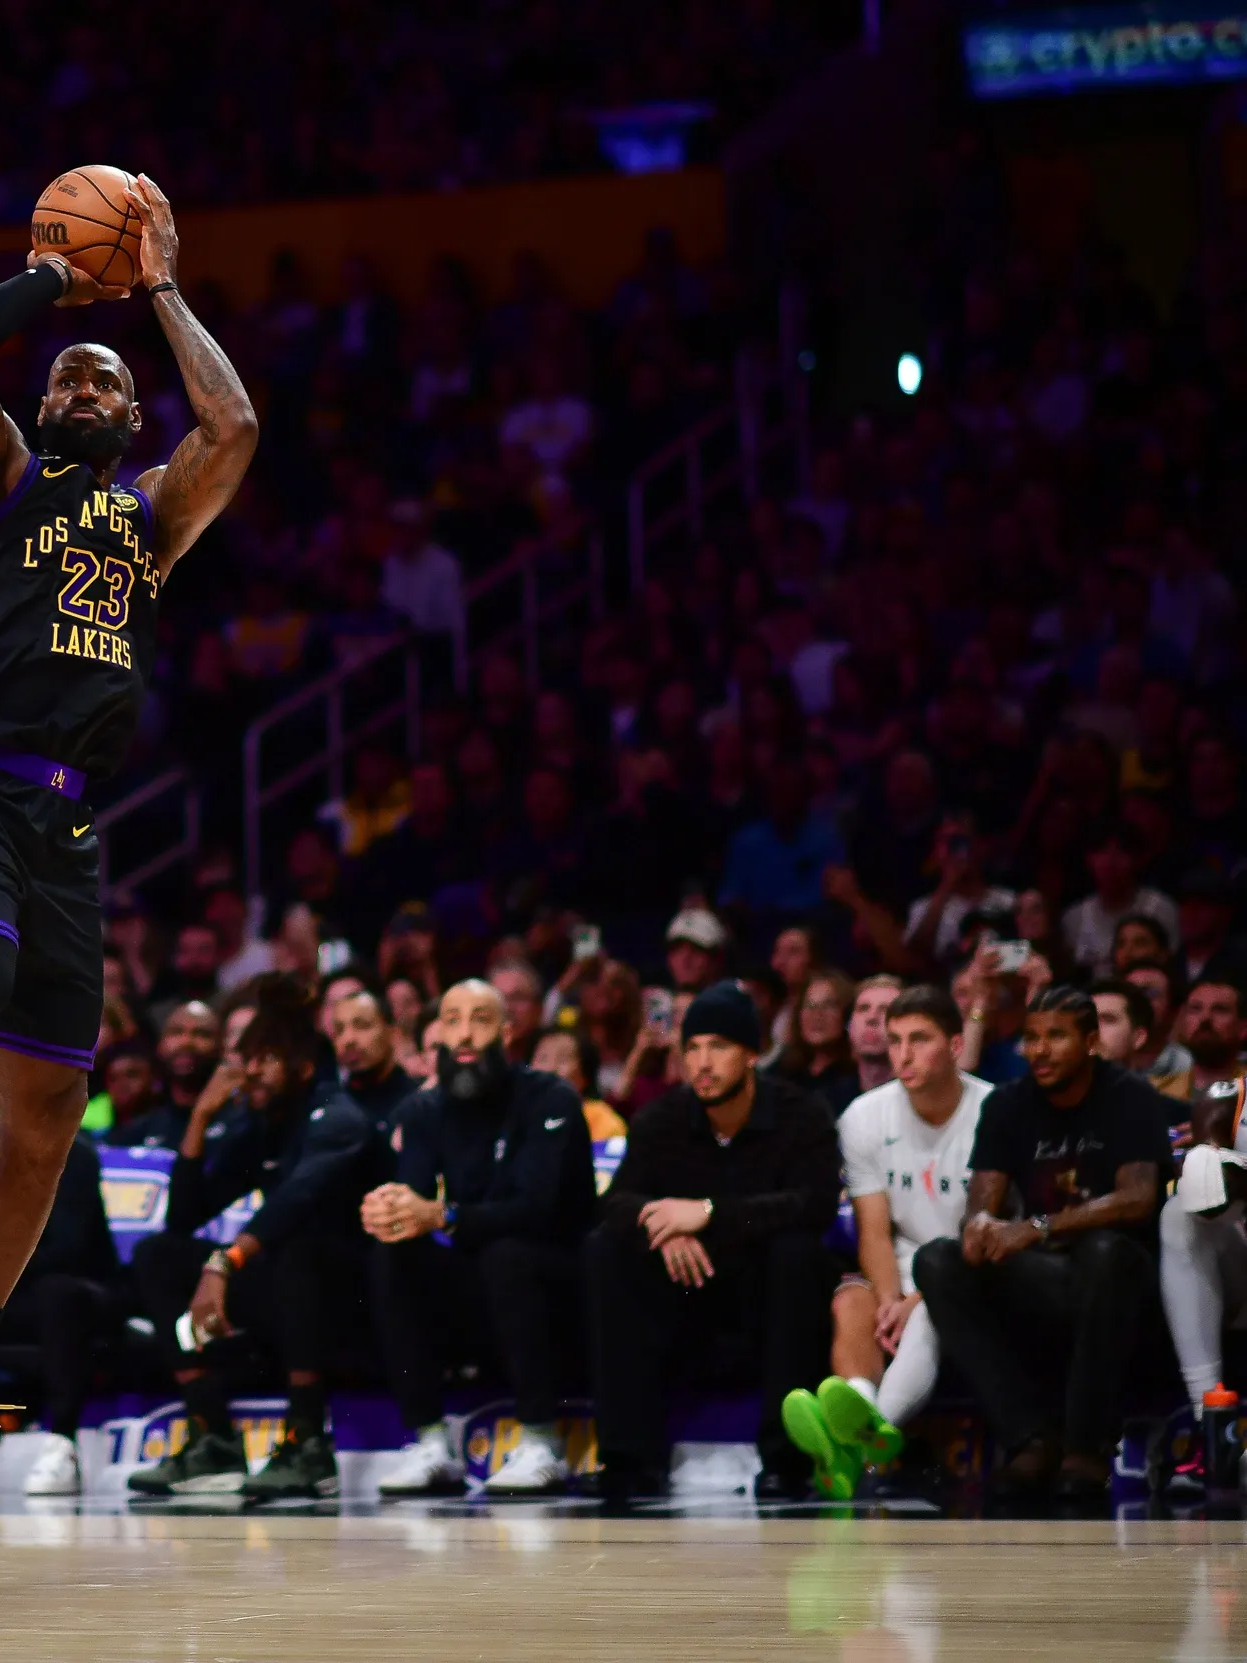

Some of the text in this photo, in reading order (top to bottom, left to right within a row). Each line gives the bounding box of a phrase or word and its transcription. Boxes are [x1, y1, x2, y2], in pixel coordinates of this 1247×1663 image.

[23, 517, 69, 568] LOS
[78, 490, 160, 600] ANGELES
[57, 546, 136, 631] 23
[50, 622, 132, 670] LAKERS
